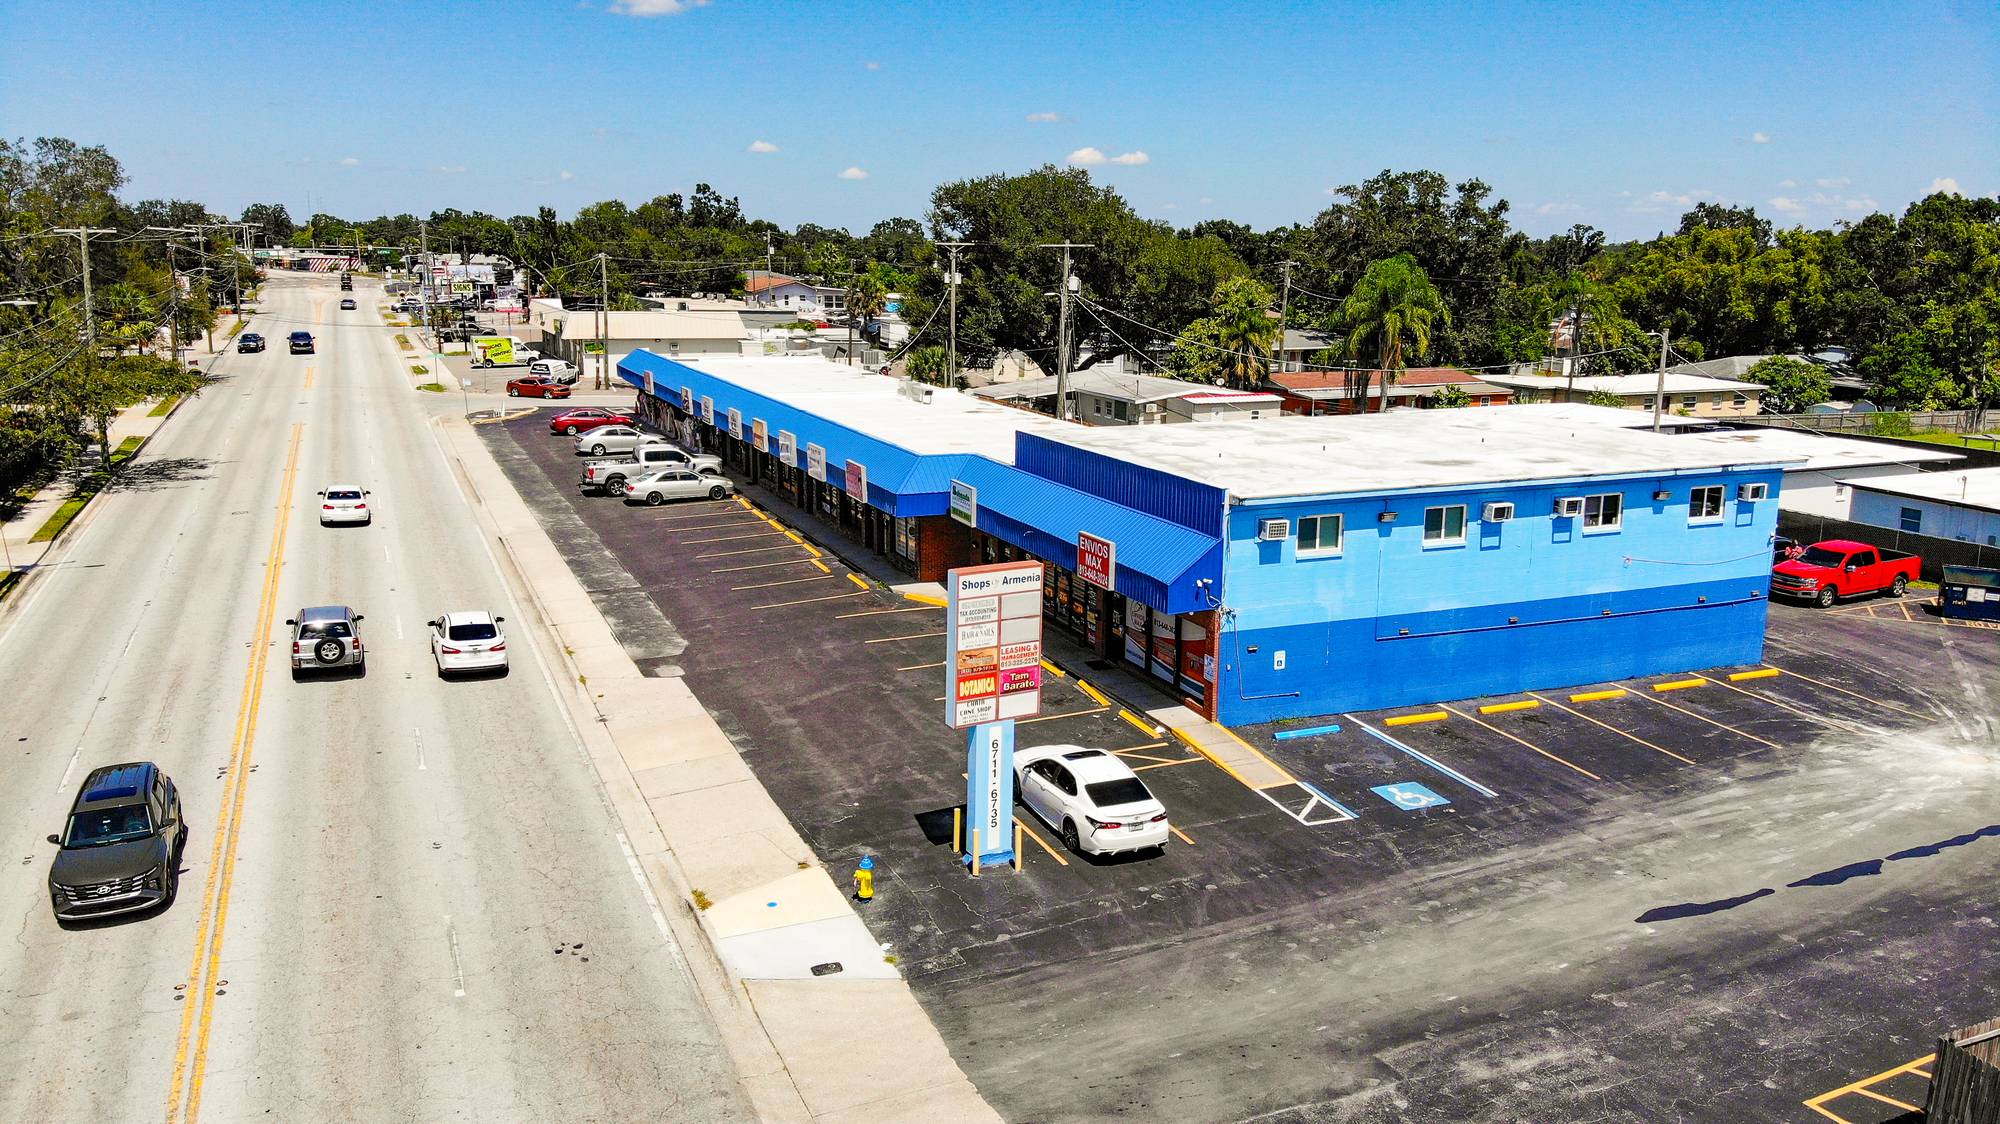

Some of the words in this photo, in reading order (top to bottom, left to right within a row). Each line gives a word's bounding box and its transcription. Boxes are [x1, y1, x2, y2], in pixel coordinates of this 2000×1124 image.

[453, 283, 471, 292] SIGNS
[1080, 536, 1108, 559] ENVIOS
[1085, 552, 1102, 571] MAX
[961, 580, 991, 591] Shops
[1002, 573, 1041, 586] Armenia
[969, 606, 997, 616] ACCOUNTING
[979, 626, 995, 638] NAILS
[1001, 645, 1031, 656] LEASING
[1032, 644, 1038, 652] &
[1001, 651, 1038, 662] MANAGEMENT
[1010, 672, 1029, 681] Tam
[959, 677, 995, 697] BOTANICA
[1003, 680, 1035, 691] Barato
[977, 705, 992, 714] SHOP
